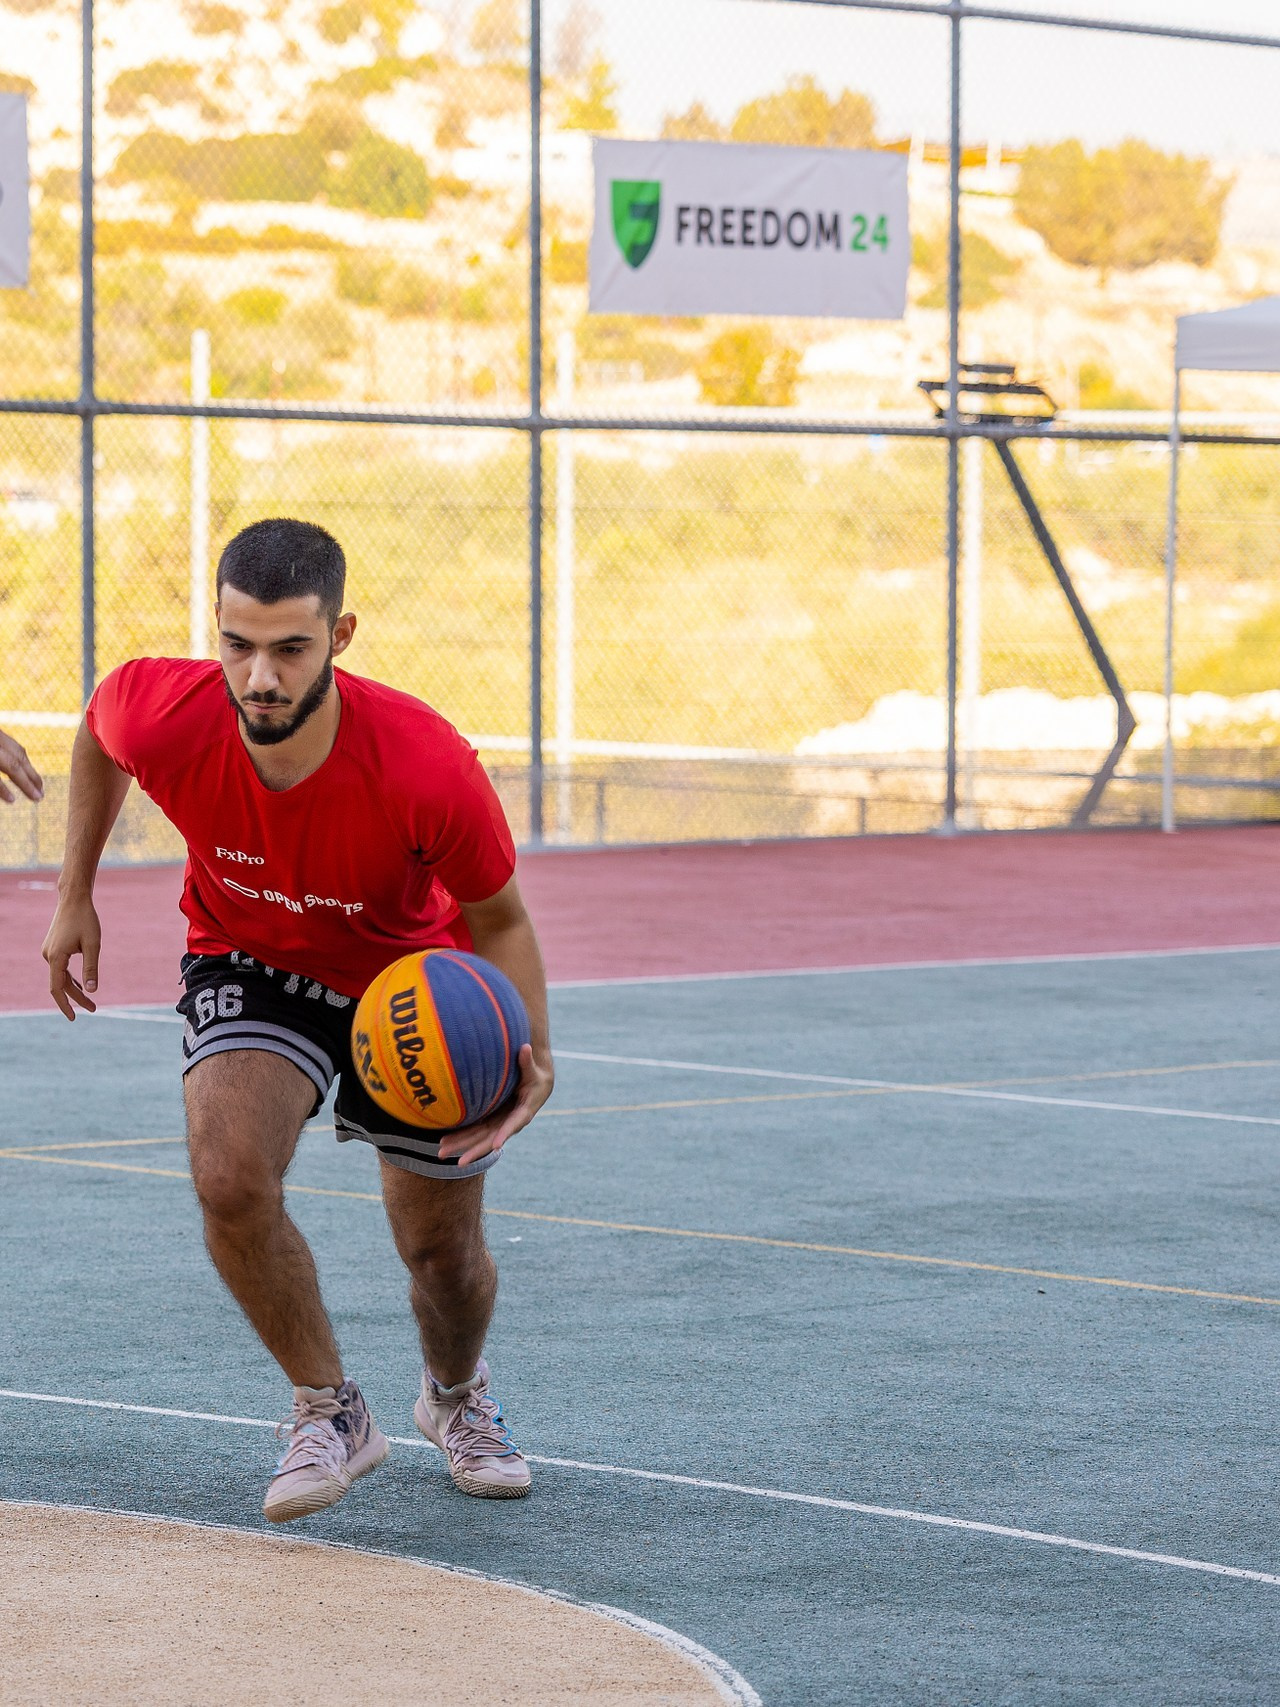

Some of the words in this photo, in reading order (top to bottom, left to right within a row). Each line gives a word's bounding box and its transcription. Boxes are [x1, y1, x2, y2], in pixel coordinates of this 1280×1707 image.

[676, 206, 841, 250] FREEDOM
[215, 846, 265, 865] FxPro
[263, 889, 303, 914] OPEN
[305, 894, 364, 916] SPOTS
[194, 984, 243, 1029] 66
[390, 985, 437, 1112] Wilson
